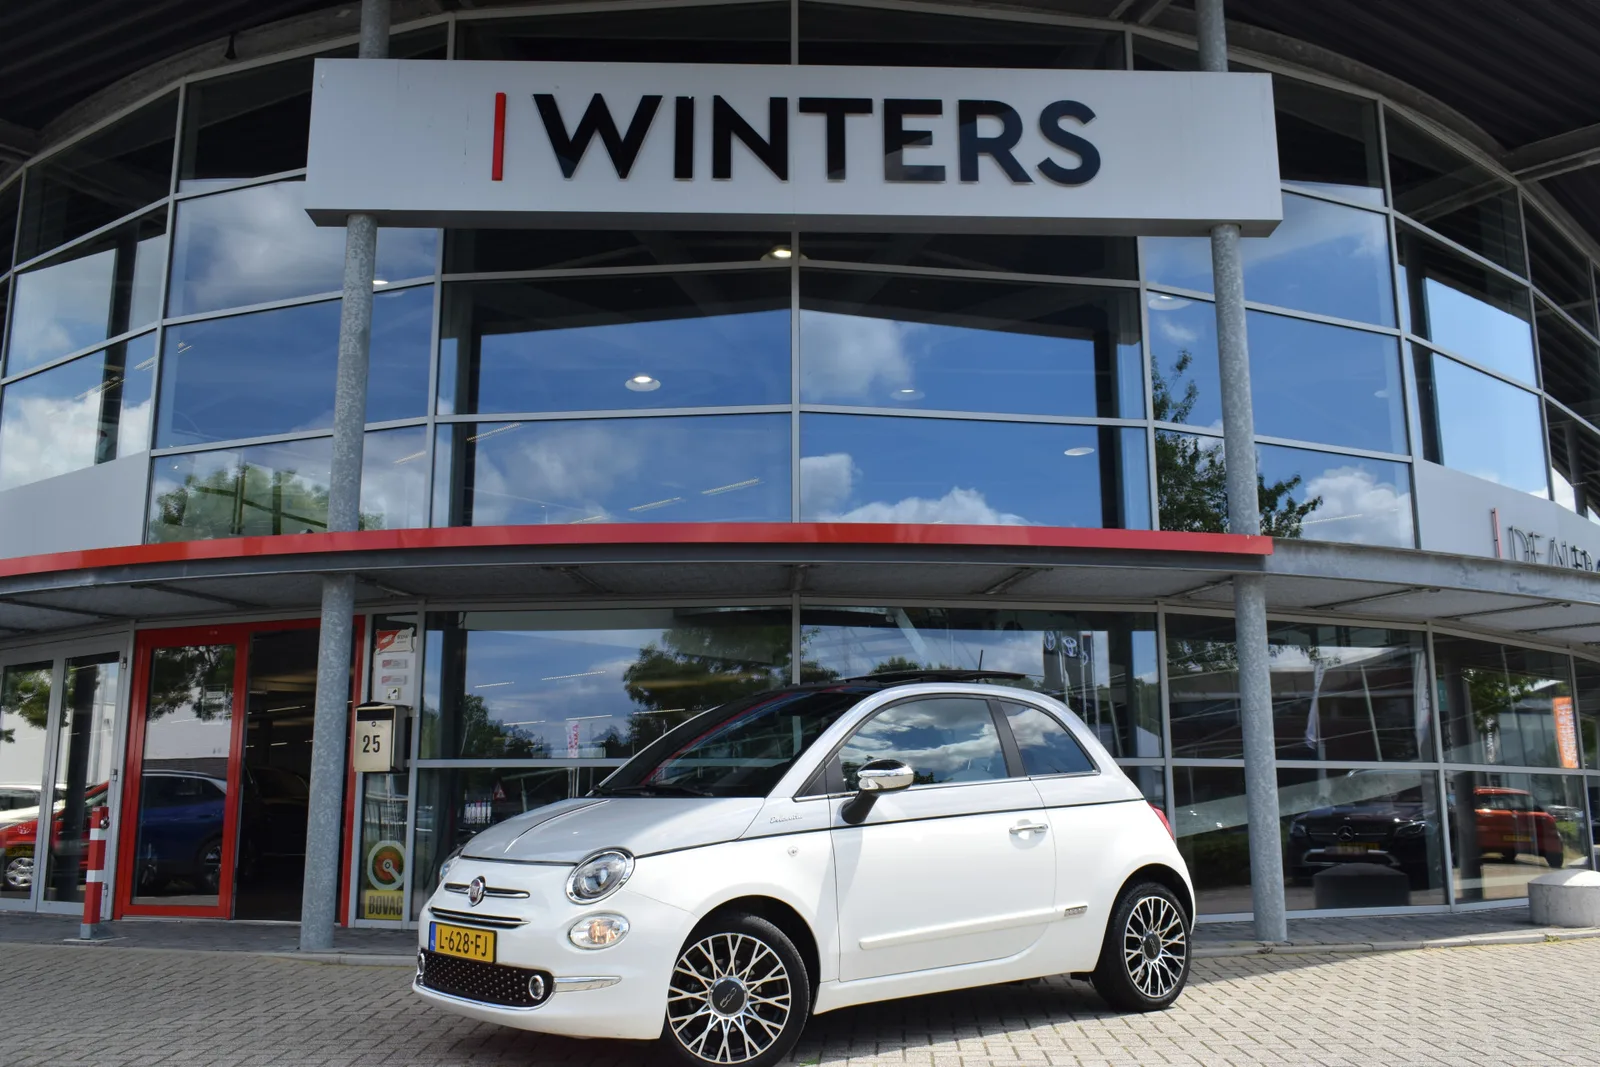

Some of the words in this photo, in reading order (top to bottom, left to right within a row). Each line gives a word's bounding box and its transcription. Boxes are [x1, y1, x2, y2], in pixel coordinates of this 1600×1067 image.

[533, 92, 1102, 187] WINTERS
[362, 734, 381, 753] 25
[368, 895, 402, 916] BOVAG
[439, 929, 488, 957] L-628-FJ
